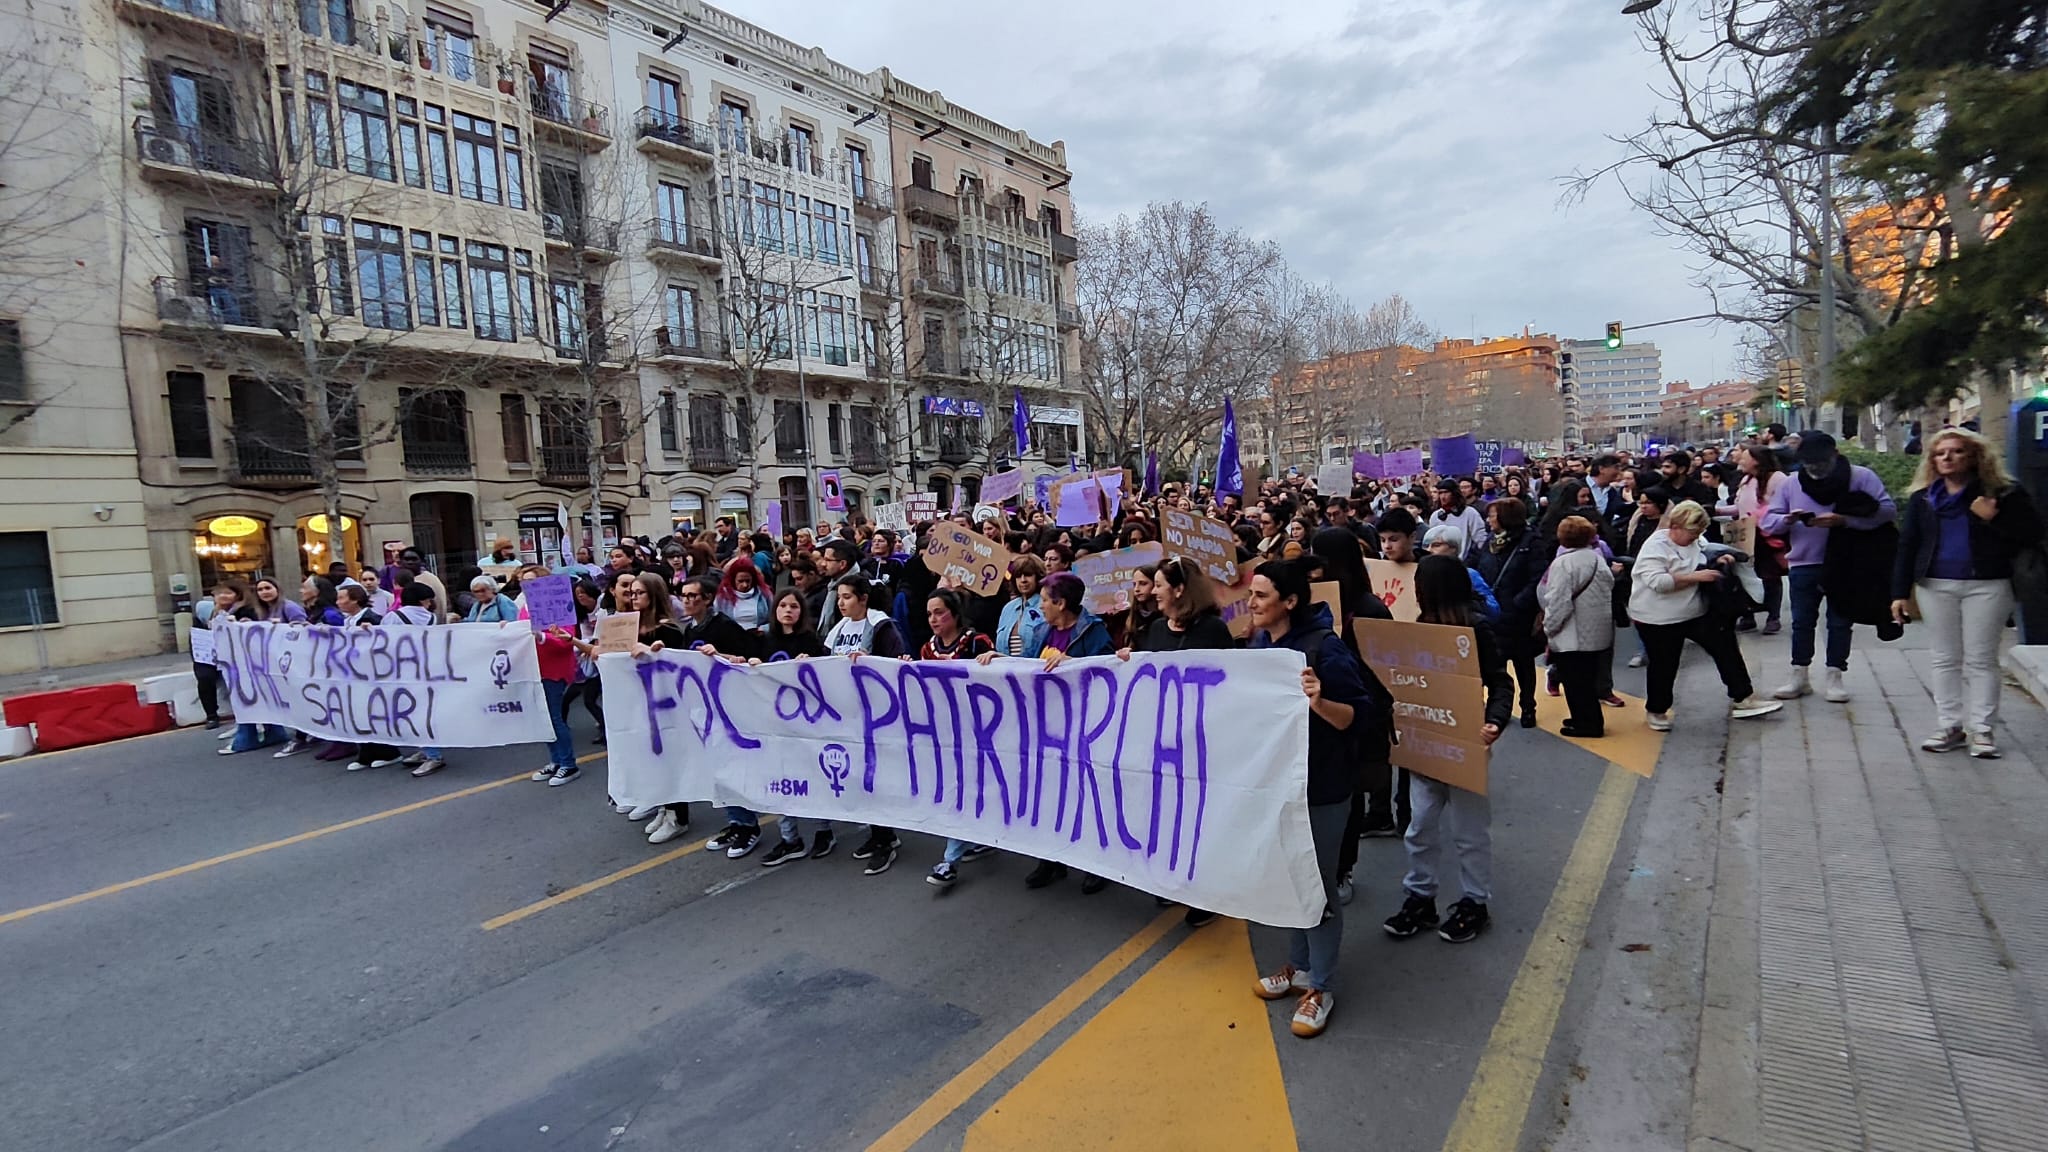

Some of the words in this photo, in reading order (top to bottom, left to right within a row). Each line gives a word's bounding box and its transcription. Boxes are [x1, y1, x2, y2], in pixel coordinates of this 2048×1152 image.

[1166, 527, 1183, 546] NO
[928, 537, 950, 556] 8M
[957, 549, 977, 564] SIN
[308, 626, 468, 683] TREBALL
[302, 683, 435, 740] SALARI
[488, 700, 523, 713] #8M
[636, 660, 762, 755] FOC
[850, 663, 1227, 881] PATRIARCAT
[769, 778, 809, 797] #8M
